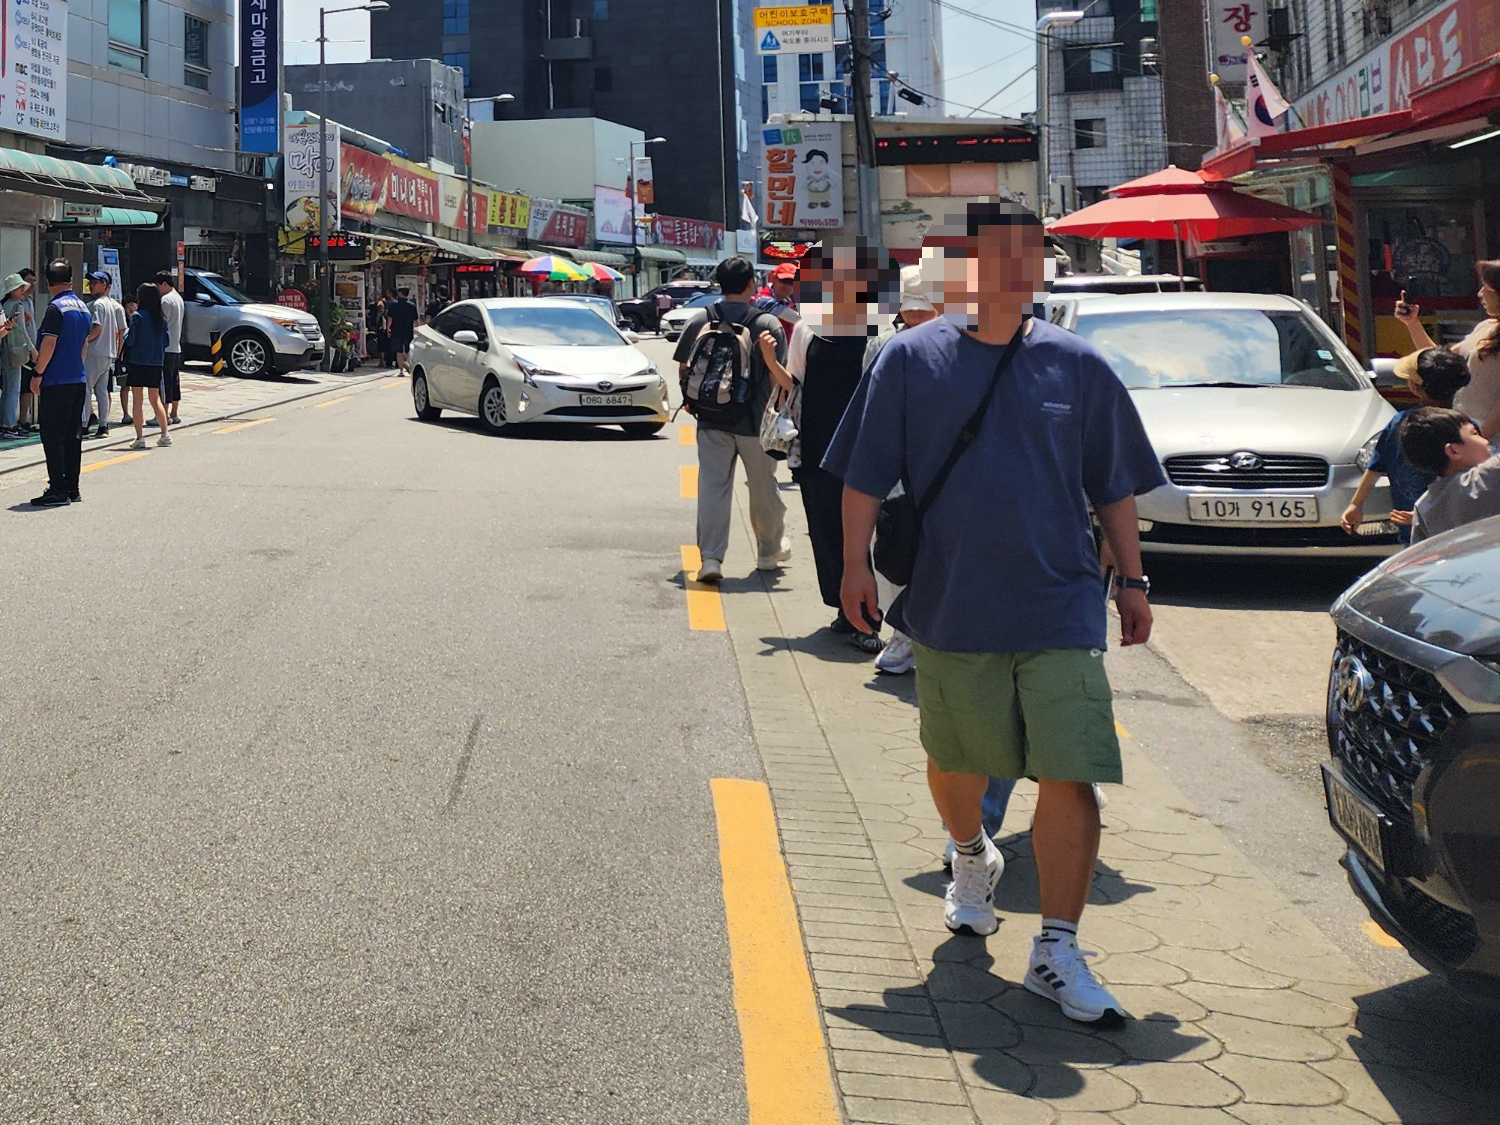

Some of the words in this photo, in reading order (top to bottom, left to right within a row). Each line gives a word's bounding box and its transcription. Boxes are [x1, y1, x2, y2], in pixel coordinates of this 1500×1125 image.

[606, 396, 628, 404] 6847
[1201, 500, 1240, 517] 10가
[1251, 500, 1306, 518] 9165
